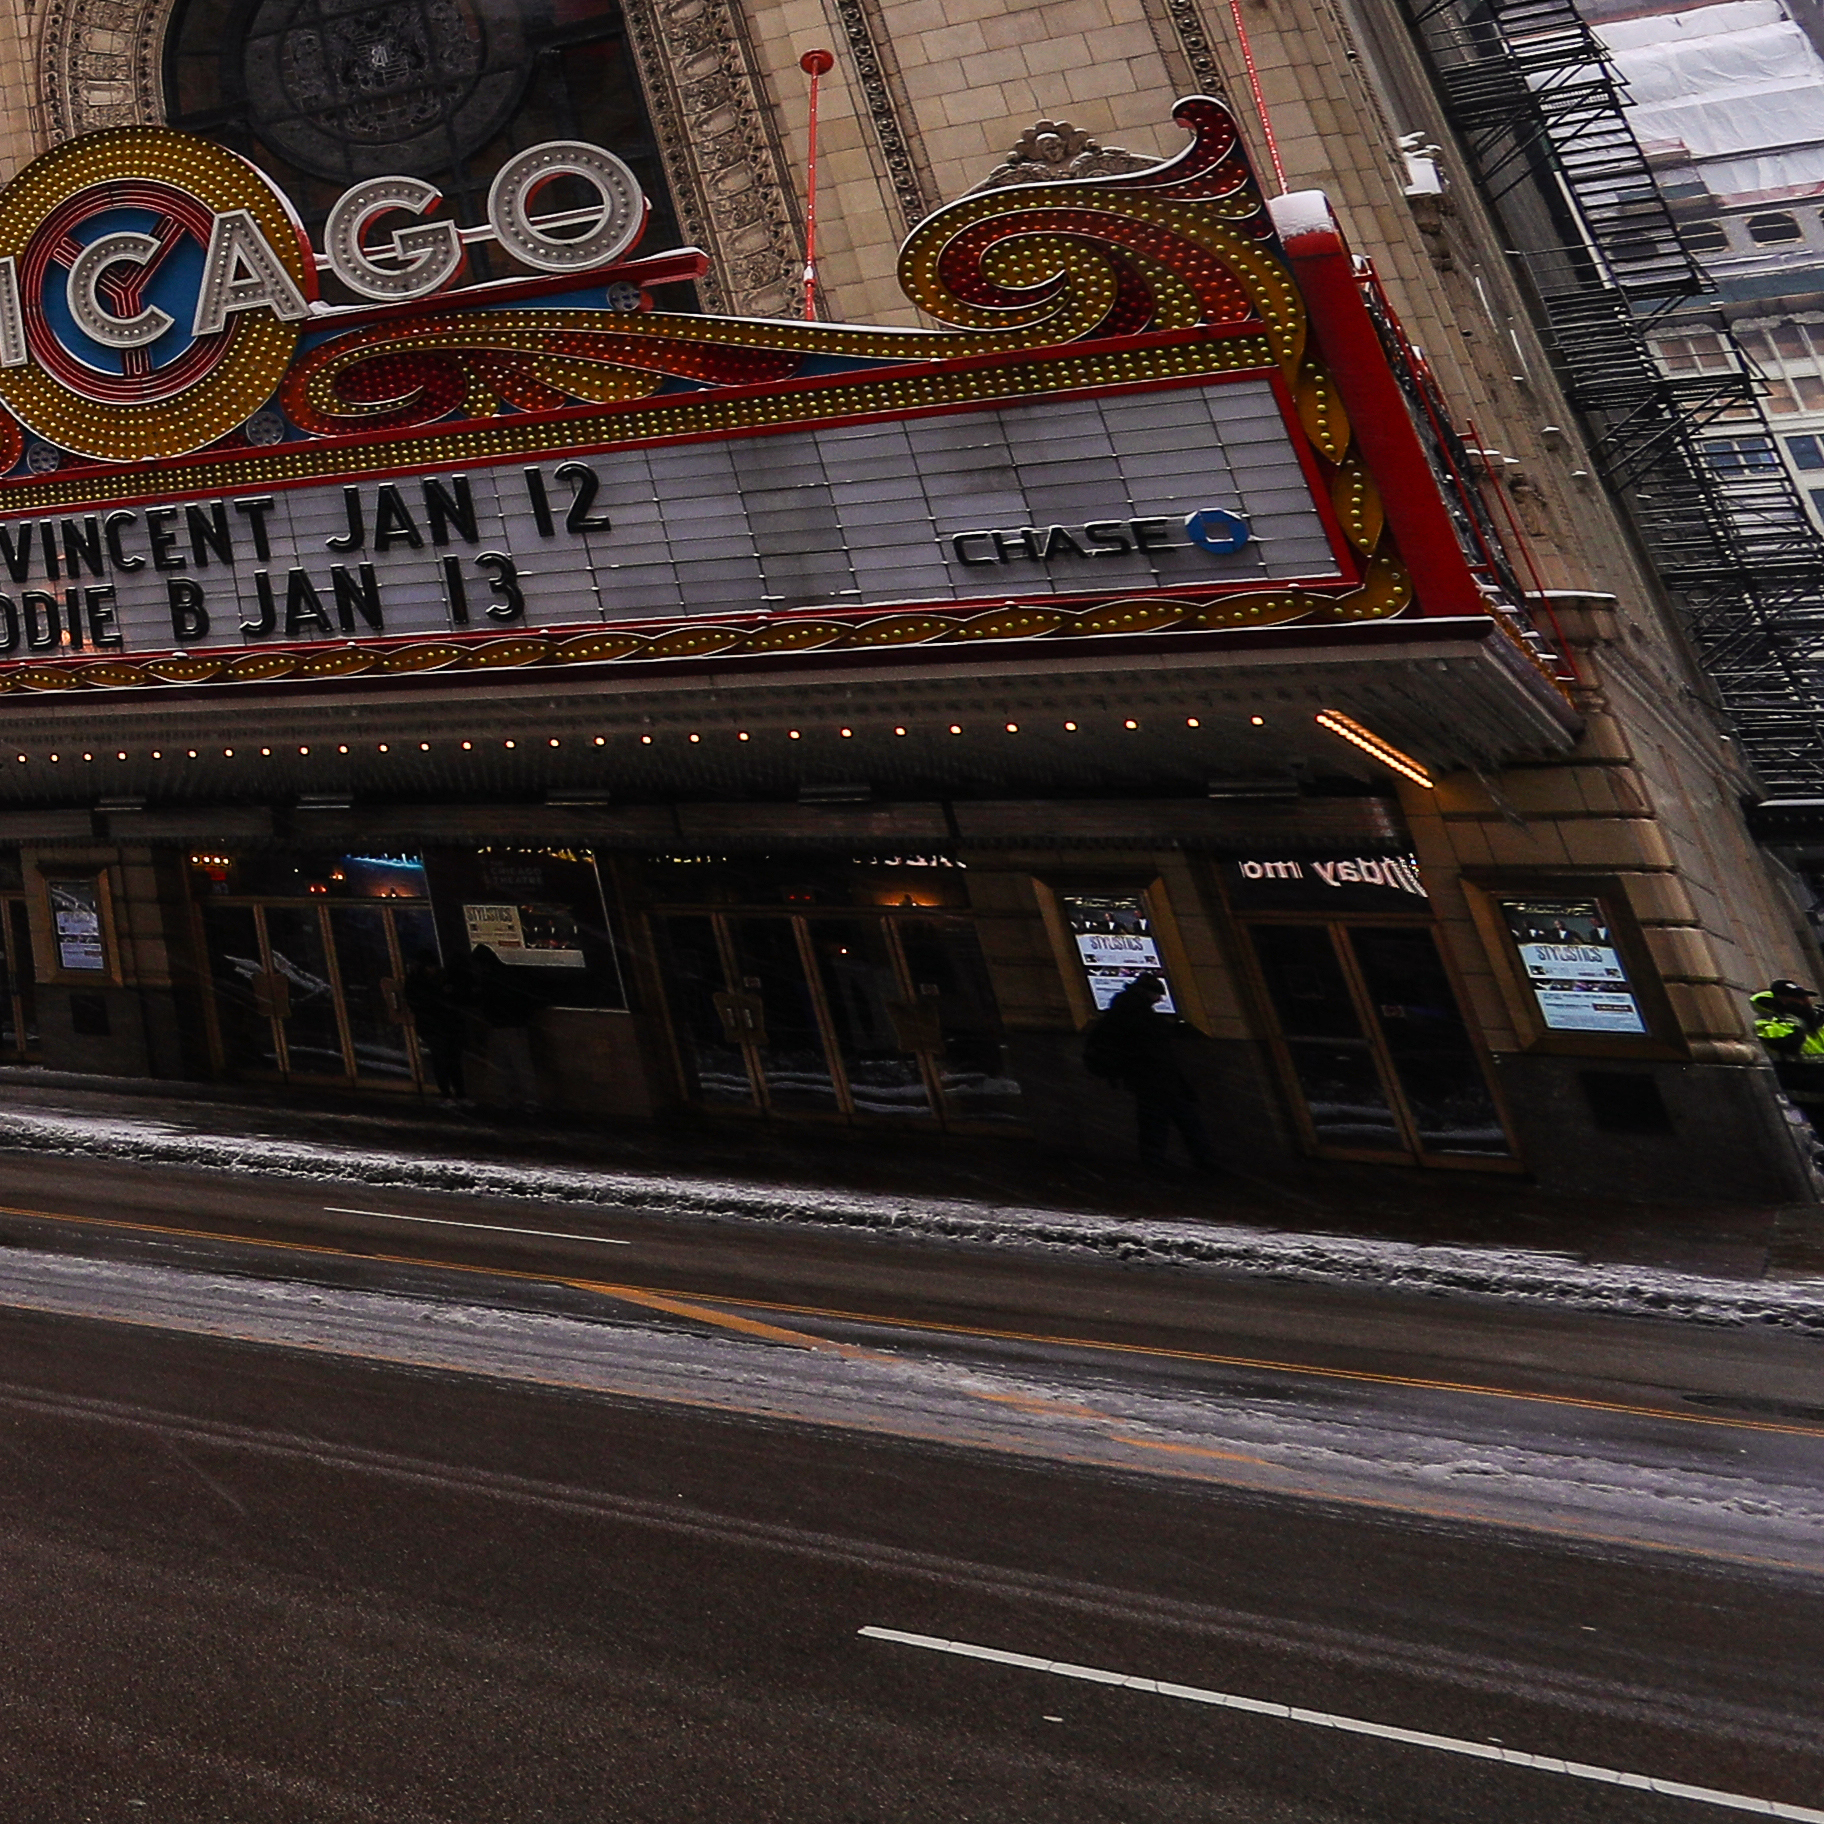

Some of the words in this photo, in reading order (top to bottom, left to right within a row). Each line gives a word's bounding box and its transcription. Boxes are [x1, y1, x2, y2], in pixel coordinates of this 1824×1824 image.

[324, 472, 480, 554] JAN
[522, 459, 613, 539] 12
[952, 516, 1174, 567] CHASE
[168, 576, 211, 643] B
[237, 560, 386, 639] JAN
[440, 549, 526, 624] 13
[1535, 945, 1604, 963] STYLISTICS
